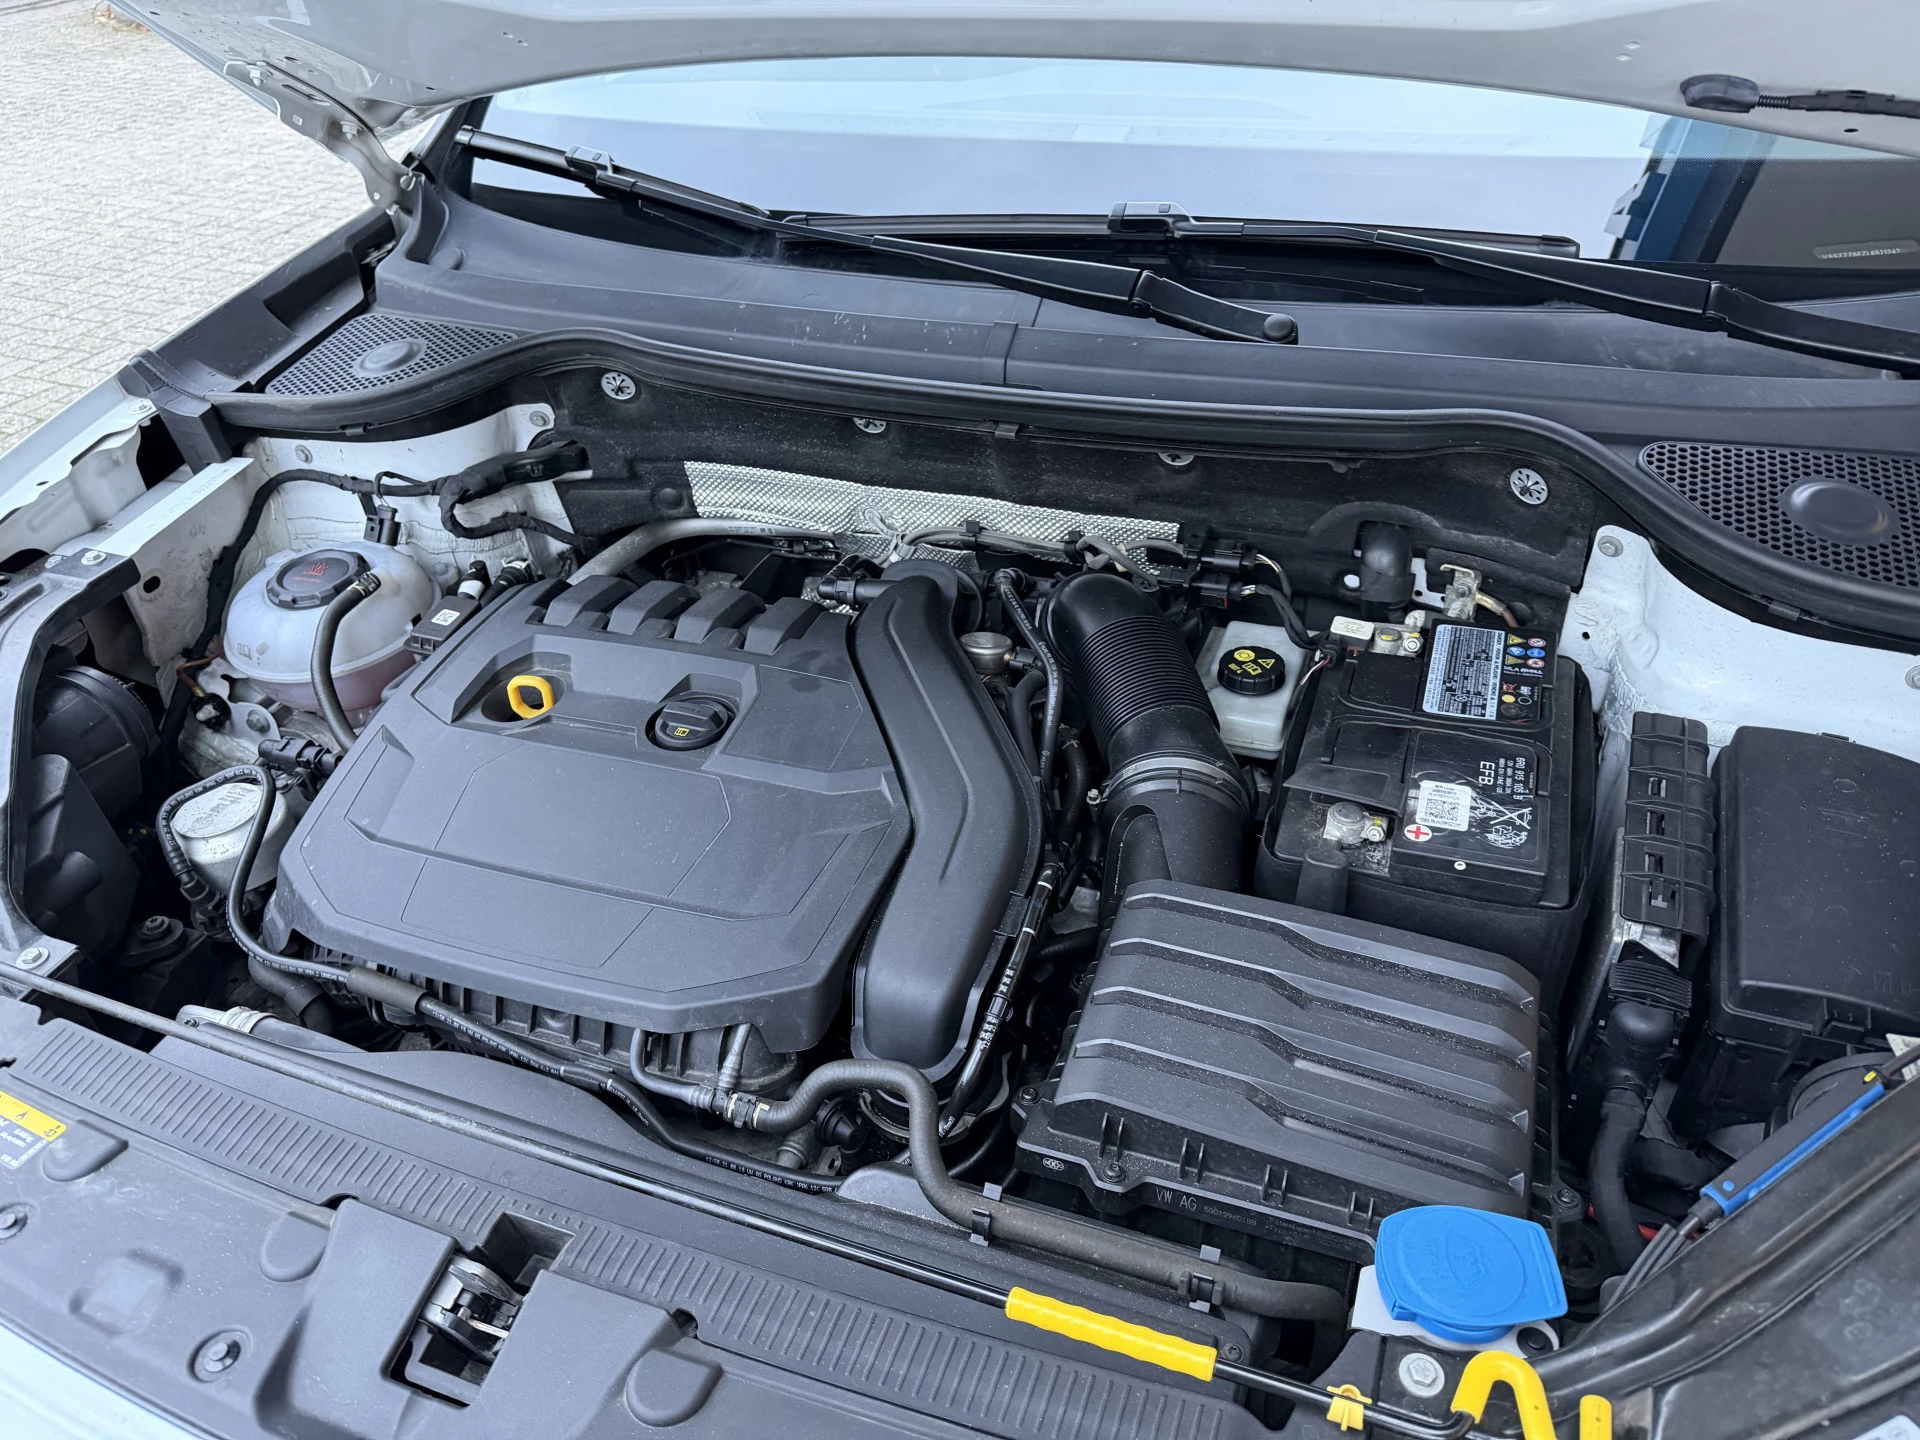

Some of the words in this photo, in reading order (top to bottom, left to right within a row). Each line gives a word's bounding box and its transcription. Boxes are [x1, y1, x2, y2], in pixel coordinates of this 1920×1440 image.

[1479, 761, 1496, 785] EFB
[764, 1174, 782, 1184] POLAND
[1156, 1186, 1173, 1204] VW
[1180, 1195, 1197, 1211] AG
